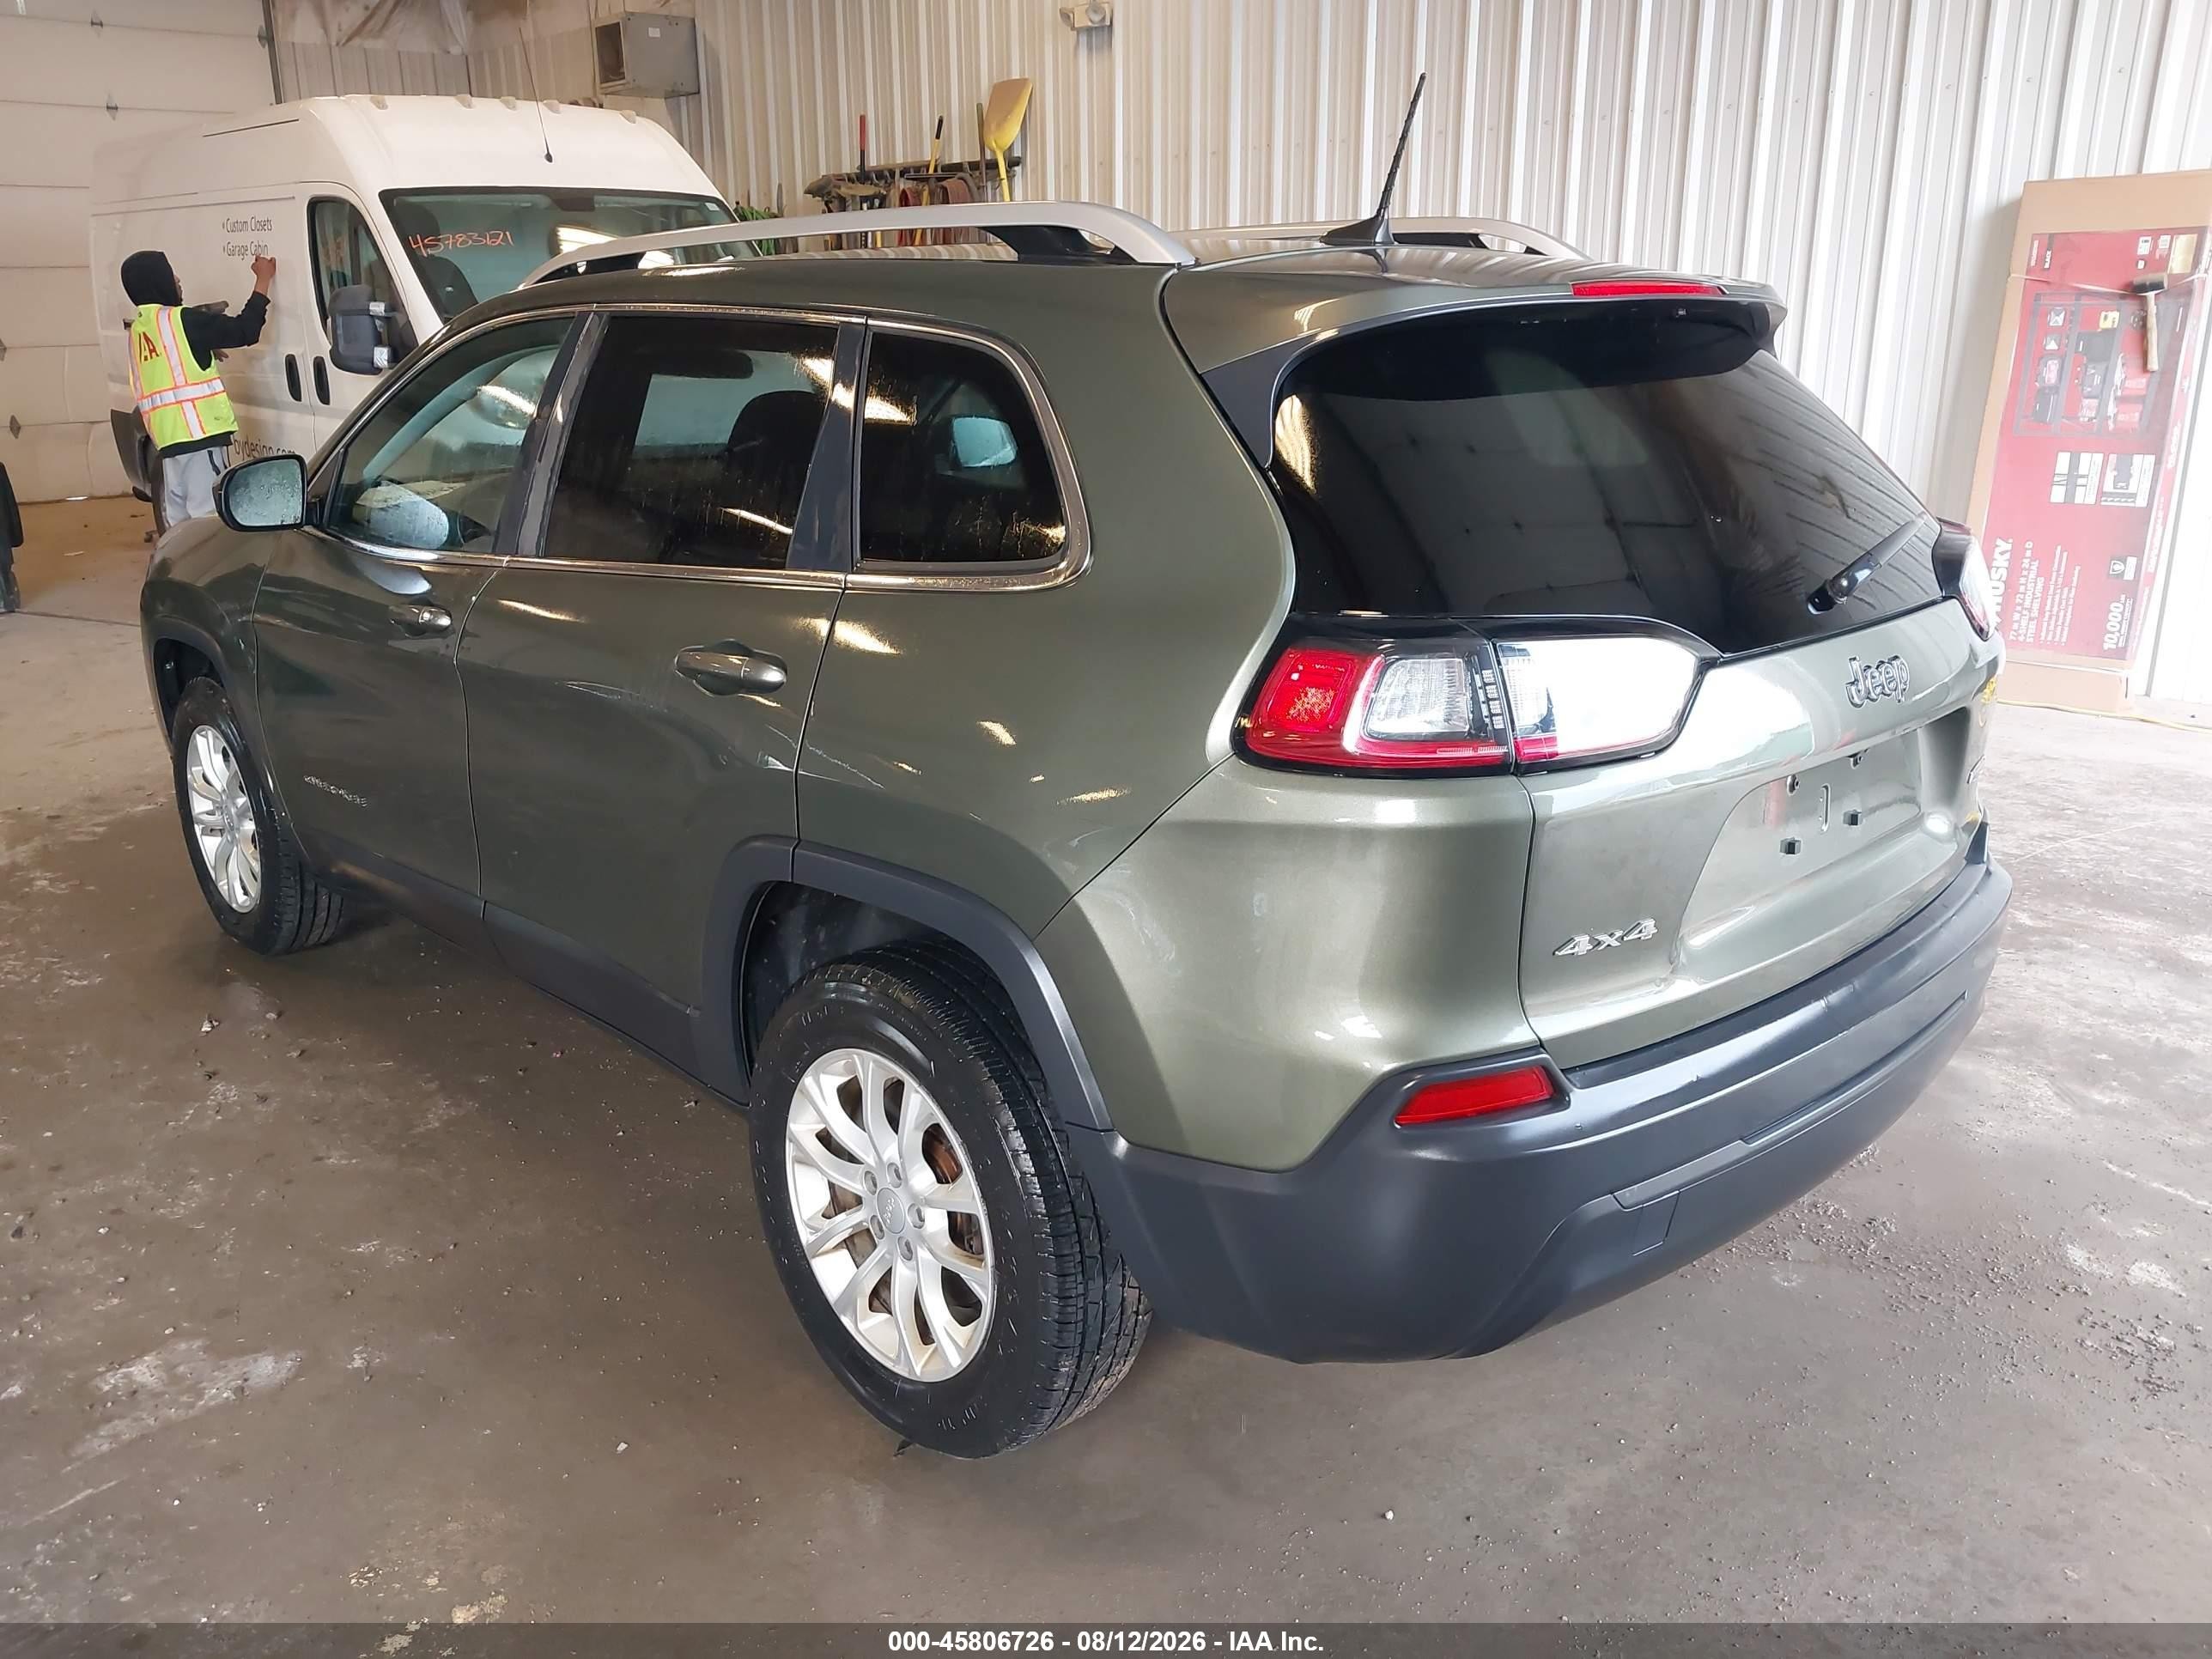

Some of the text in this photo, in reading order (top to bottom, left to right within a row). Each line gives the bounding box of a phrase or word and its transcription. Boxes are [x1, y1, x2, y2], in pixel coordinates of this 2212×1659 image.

[226, 216, 272, 233] Custom Closets
[227, 241, 248, 261] Garage
[2025, 559, 2039, 607] INDUSTRIAL
[2026, 576, 2045, 642] STEEL SHELVING
[2103, 602, 2124, 650] 10,000
[1846, 655, 1910, 708] Jeep
